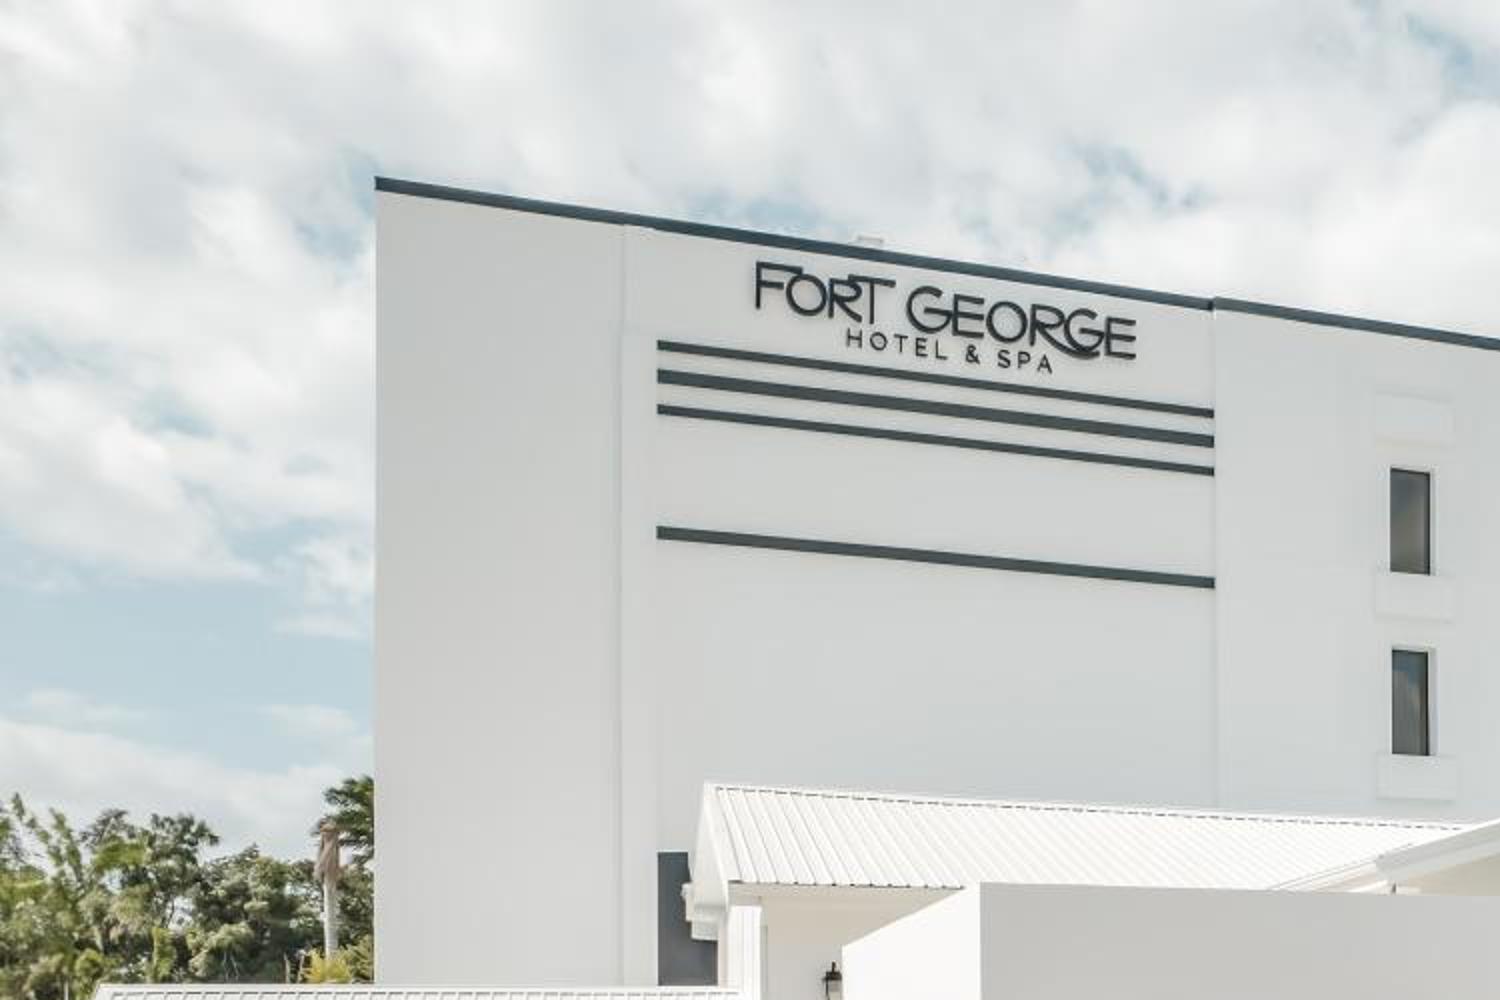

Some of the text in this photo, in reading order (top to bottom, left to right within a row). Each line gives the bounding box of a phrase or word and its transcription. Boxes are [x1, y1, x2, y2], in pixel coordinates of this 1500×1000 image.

[755, 261, 1137, 360] FORT GEORGE
[846, 328, 1053, 375] HOTEL & SPA
